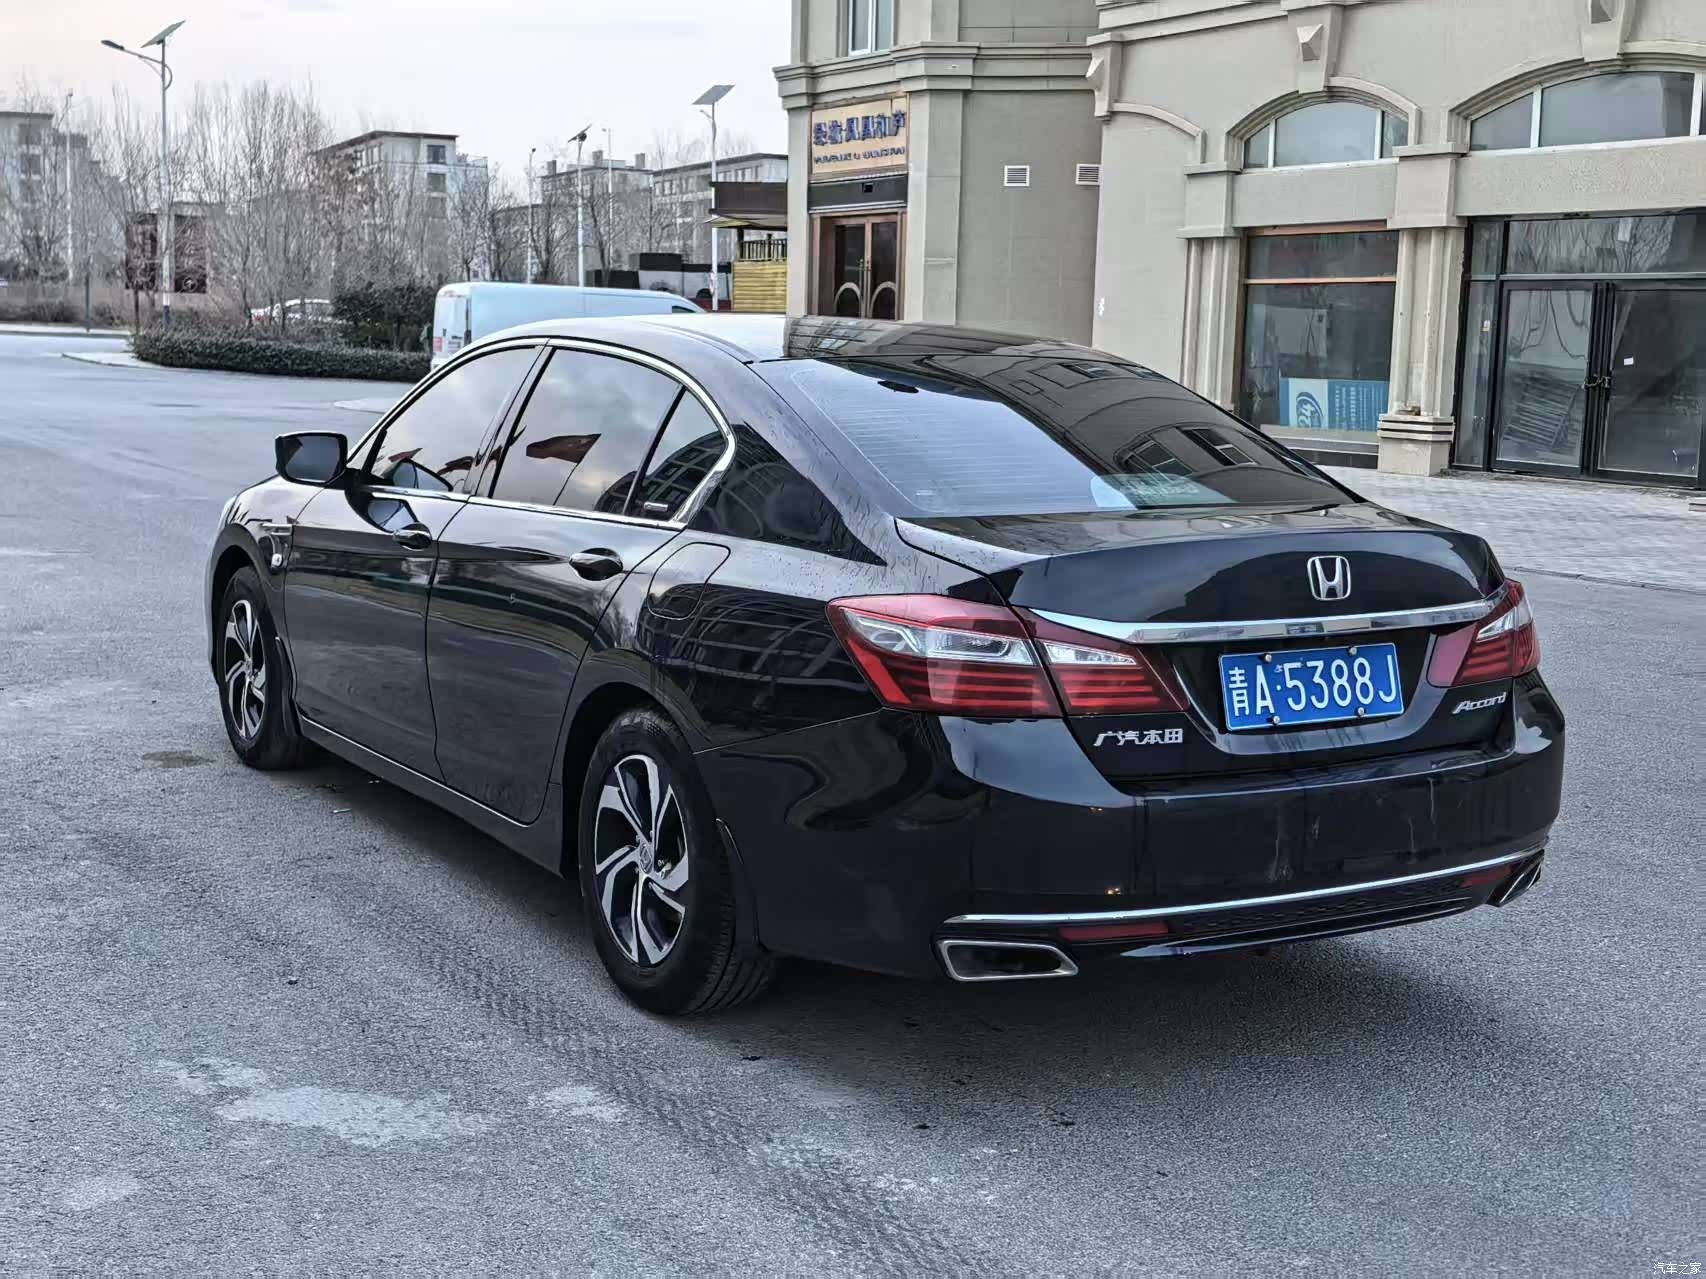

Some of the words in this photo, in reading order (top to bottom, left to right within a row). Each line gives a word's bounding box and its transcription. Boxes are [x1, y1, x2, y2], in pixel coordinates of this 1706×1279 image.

[1452, 691, 1507, 715] Accord
[1093, 728, 1184, 746] 广汽本田
